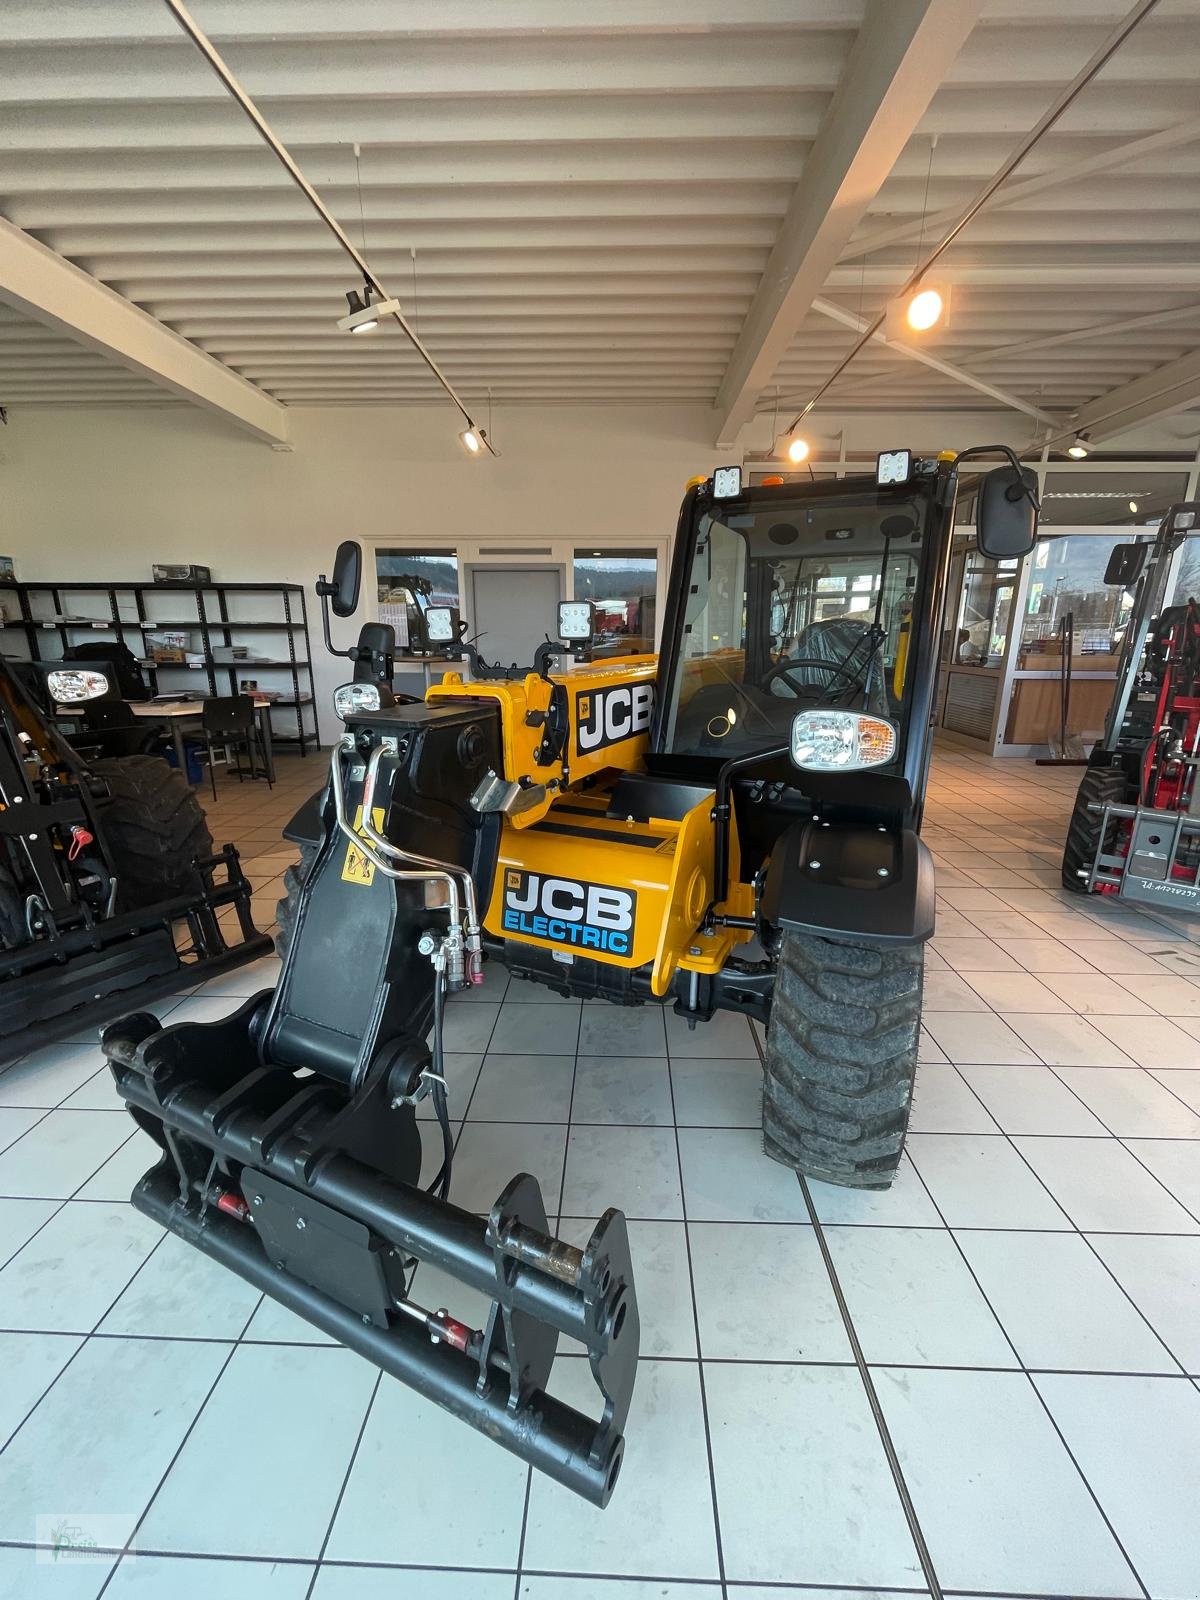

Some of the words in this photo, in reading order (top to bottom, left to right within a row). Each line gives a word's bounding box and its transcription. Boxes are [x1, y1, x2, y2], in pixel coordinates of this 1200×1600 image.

[579, 685, 654, 749] JCB
[504, 909, 628, 953] ELECTRIC
[506, 875, 633, 931] JCB
